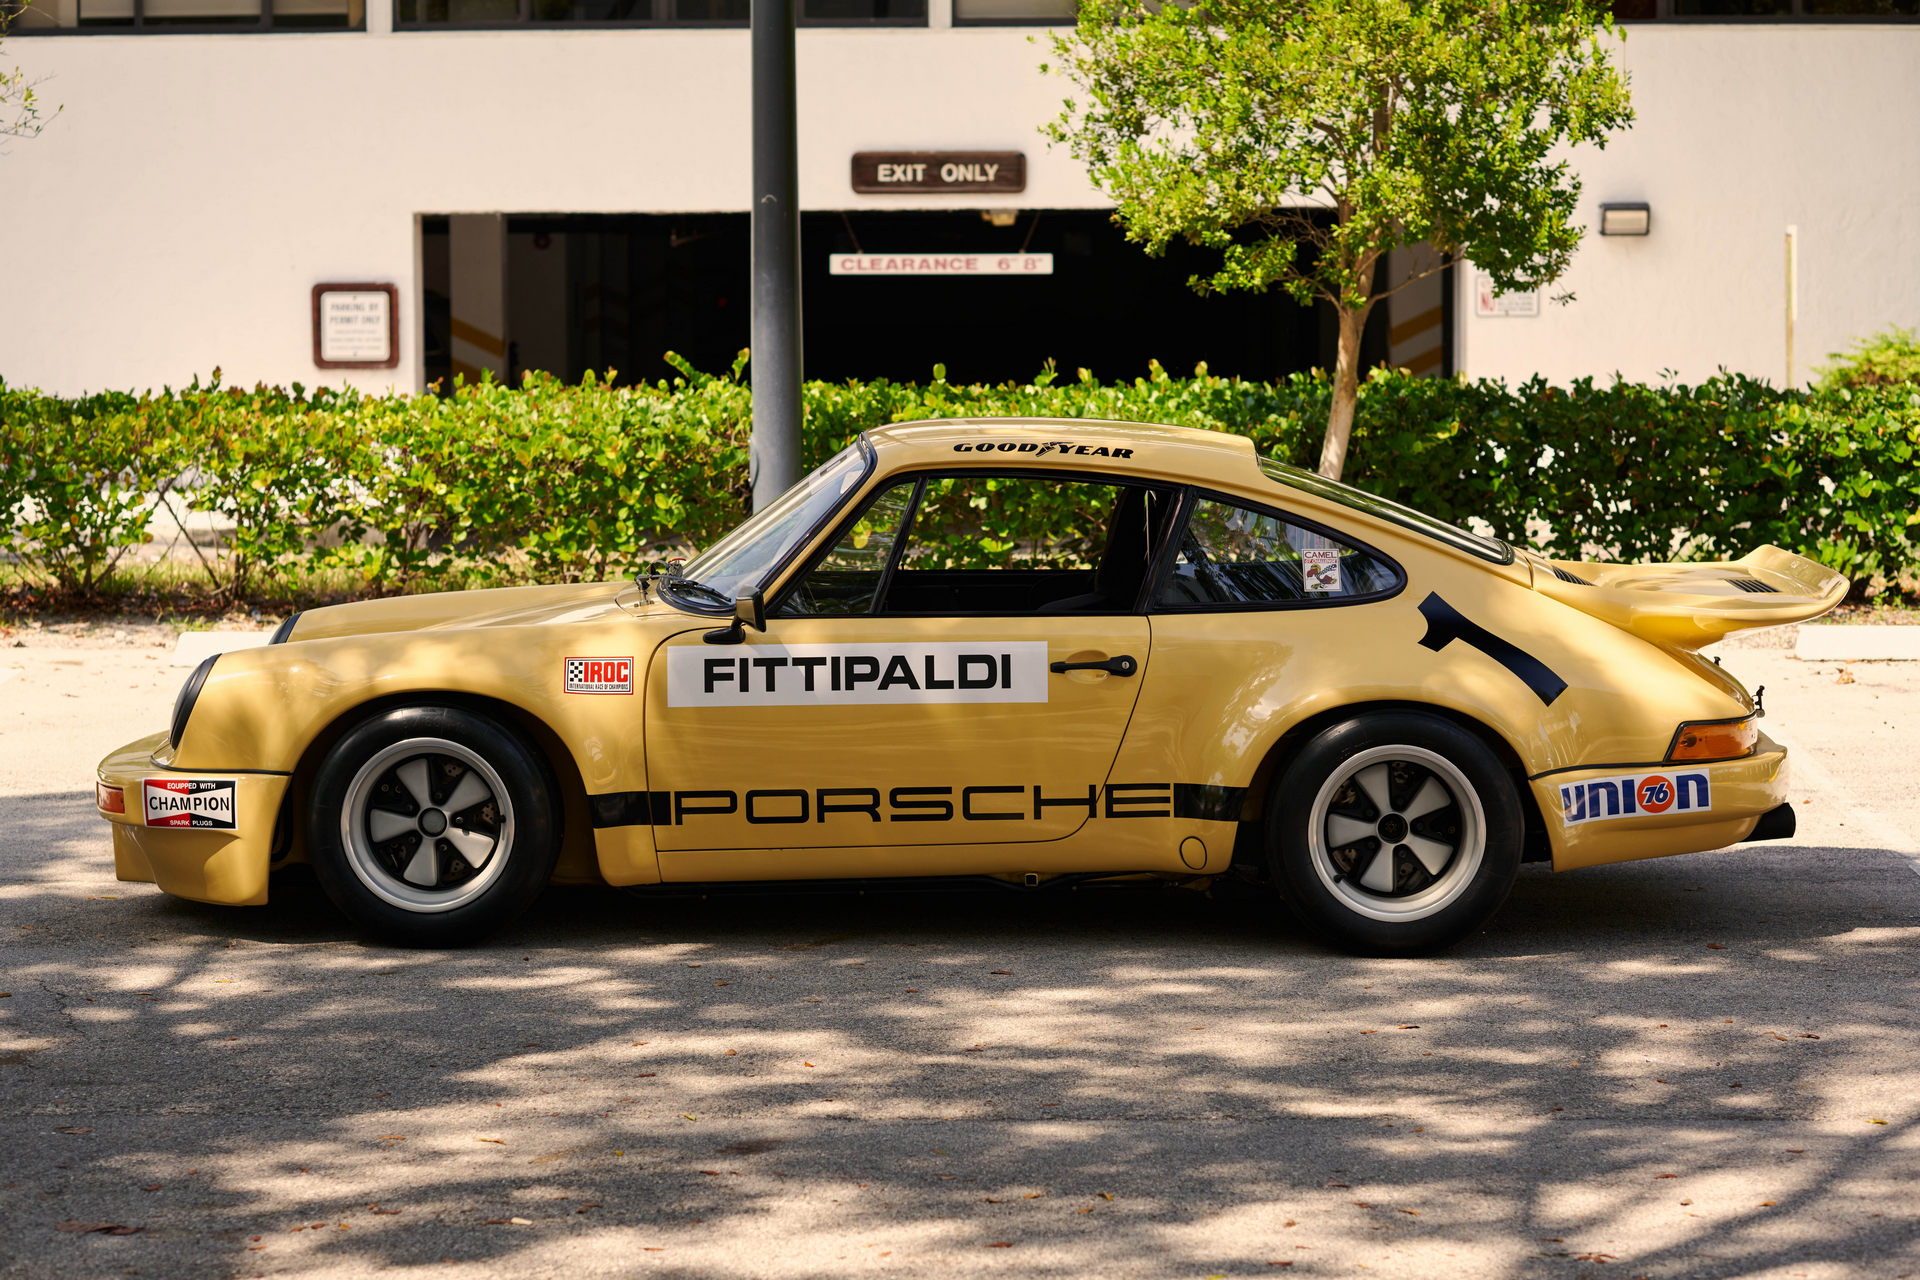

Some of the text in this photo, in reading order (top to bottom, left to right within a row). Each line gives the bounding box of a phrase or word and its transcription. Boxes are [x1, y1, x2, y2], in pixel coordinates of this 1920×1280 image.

[877, 163, 999, 183] EXIT ONLY
[841, 257, 978, 272] CLEARANCE
[584, 662, 628, 682] IROC
[703, 653, 1012, 693] FITTIPALDI
[167, 782, 216, 790] EQUIPPED WITH
[1642, 781, 1670, 806] 76
[149, 796, 229, 811] CHAMPION
[674, 783, 1171, 825] PORSCHE
